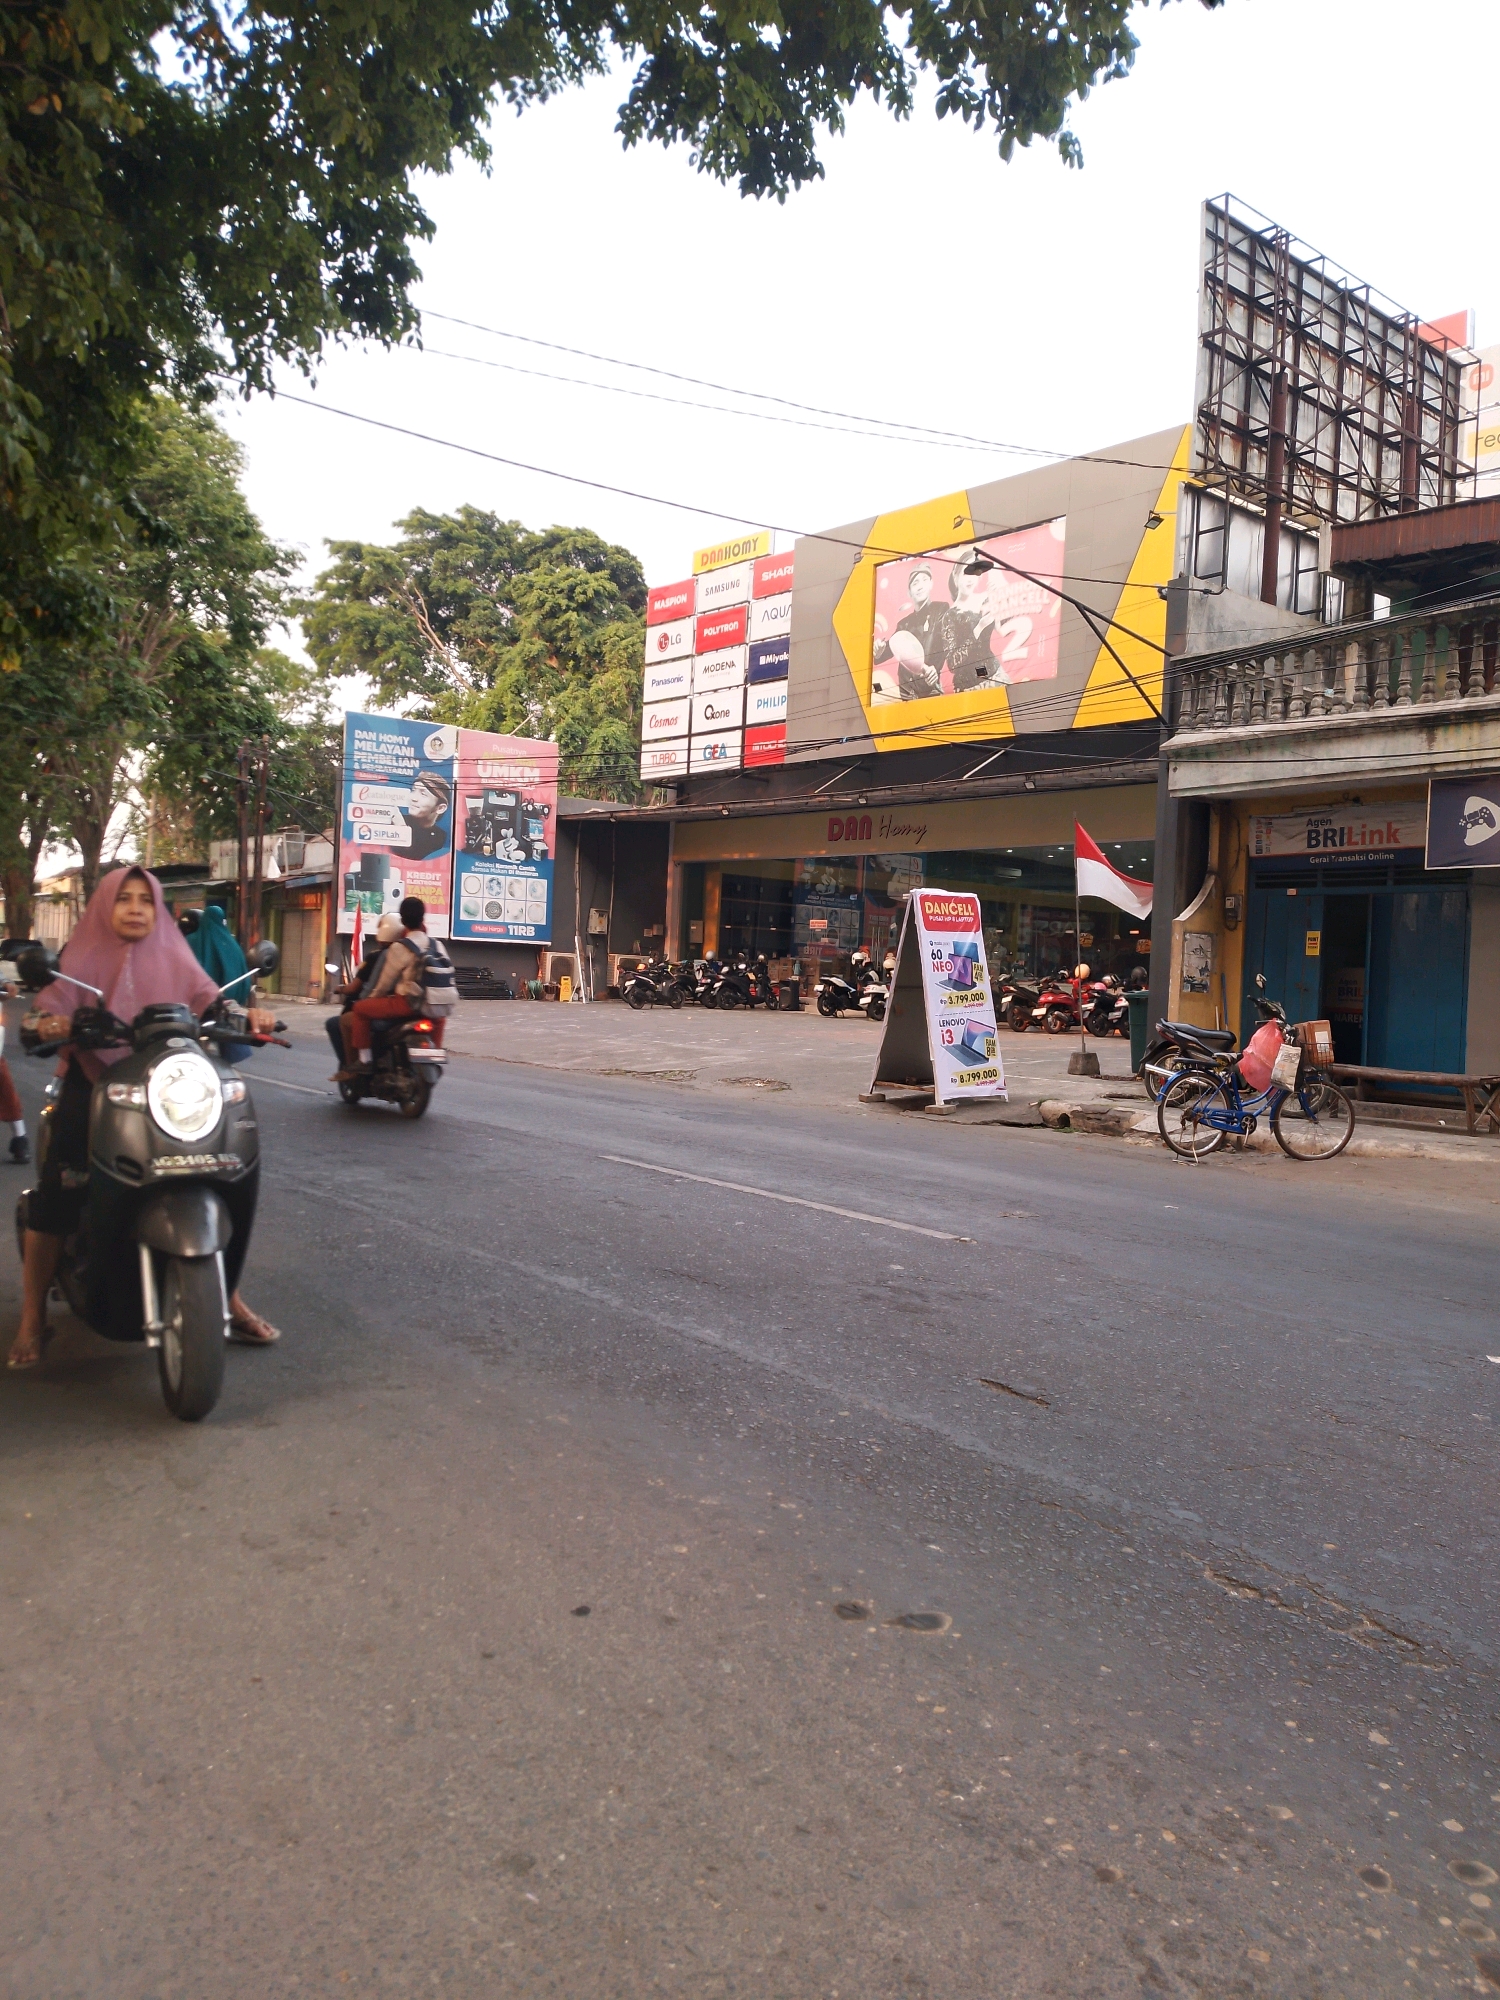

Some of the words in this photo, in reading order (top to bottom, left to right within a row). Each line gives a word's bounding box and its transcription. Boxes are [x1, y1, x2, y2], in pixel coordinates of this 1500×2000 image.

[701, 537, 759, 567] DANHOMY
[705, 579, 740, 596] SAMSUNG
[654, 593, 687, 610] MASPION
[703, 621, 739, 637] POLYTRON
[1002, 616, 1033, 661] 2
[765, 652, 790, 665] Miyak
[702, 660, 736, 674] MODENA
[651, 674, 684, 687] Panasonic
[650, 714, 679, 729] Cosmos
[354, 729, 376, 741] DAN
[379, 732, 410, 745] HOMY
[354, 739, 415, 757] MELAYANI
[492, 744, 527, 756] Pusatnya
[703, 743, 727, 761] GEA
[354, 750, 420, 769] PEMBELIAN
[477, 760, 540, 783] UMKM
[365, 809, 391, 817] INAPROC
[828, 814, 872, 841] DAN
[879, 814, 928, 845] Homy
[1306, 818, 1332, 829] Agen
[373, 830, 400, 838] SIPLah
[1306, 821, 1401, 849] BRILink
[1309, 856, 1330, 864] Gerai
[1331, 853, 1366, 863] Transaksi
[1368, 852, 1395, 861] Online
[406, 871, 441, 880] KREDIT
[407, 885, 443, 896] TANPA
[924, 901, 975, 916] DANCELL
[507, 925, 536, 936] 11RB
[931, 949, 942, 960] 60
[932, 961, 953, 973] NEO
[948, 992, 985, 1005] 3.799.000
[939, 1018, 966, 1027] LENOVO
[941, 1029, 954, 1045] i3
[959, 1069, 998, 1084] 8.799.000
